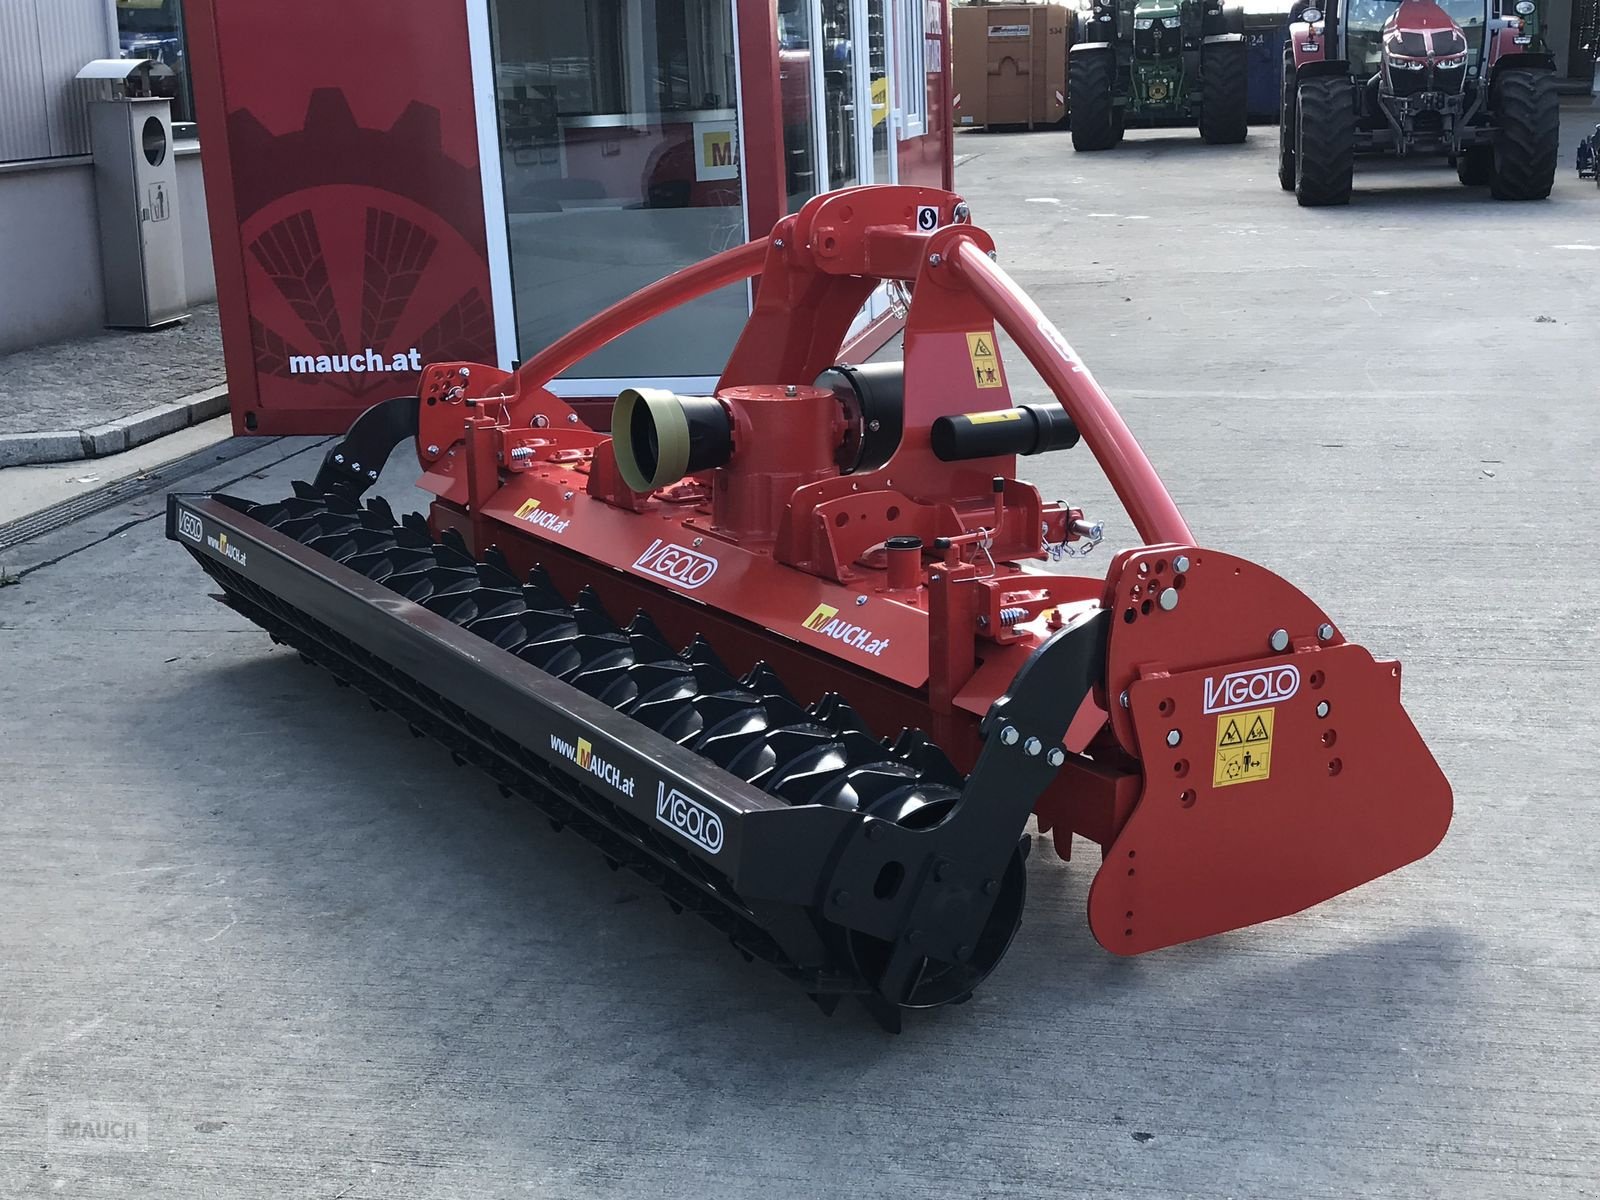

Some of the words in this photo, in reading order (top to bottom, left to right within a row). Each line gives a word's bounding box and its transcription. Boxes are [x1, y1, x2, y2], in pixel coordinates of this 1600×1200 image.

[289, 348, 422, 374] mauch.at
[179, 508, 203, 542] VIGOLO
[514, 499, 571, 534] MAUCH.at
[632, 538, 719, 590] VIGOLO
[804, 605, 890, 656] MAUCH.at
[1203, 664, 1300, 715] VIGOLO
[550, 734, 635, 798] www.MAUCH.at
[656, 780, 724, 855] VIGOLO
